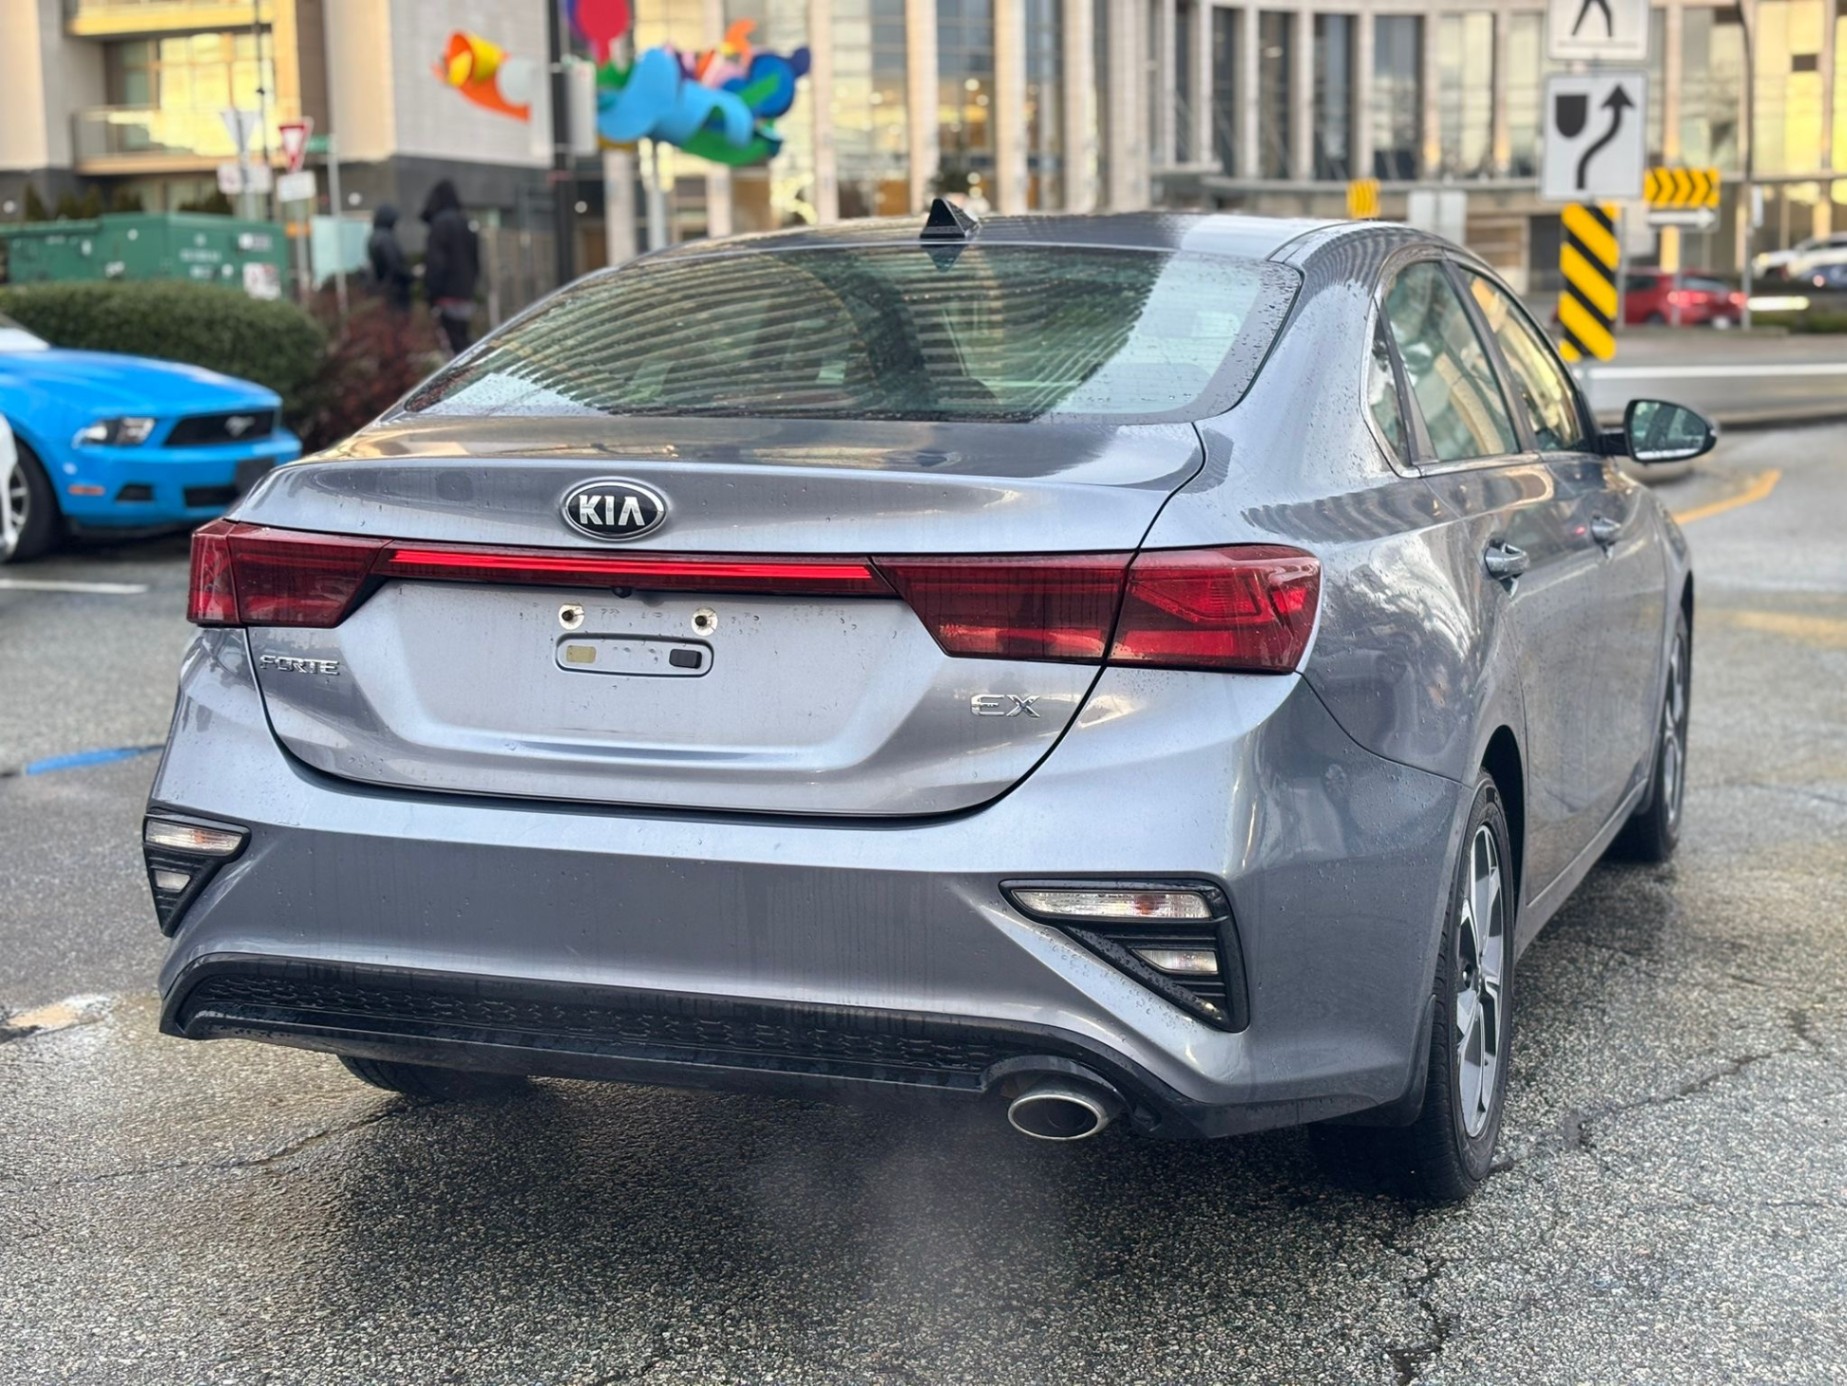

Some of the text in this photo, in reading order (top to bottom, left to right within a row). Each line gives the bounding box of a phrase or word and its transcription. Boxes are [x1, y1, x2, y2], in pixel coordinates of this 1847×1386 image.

[578, 494, 646, 526] KIA
[259, 653, 340, 676] FORTE
[970, 693, 1041, 718] EX
